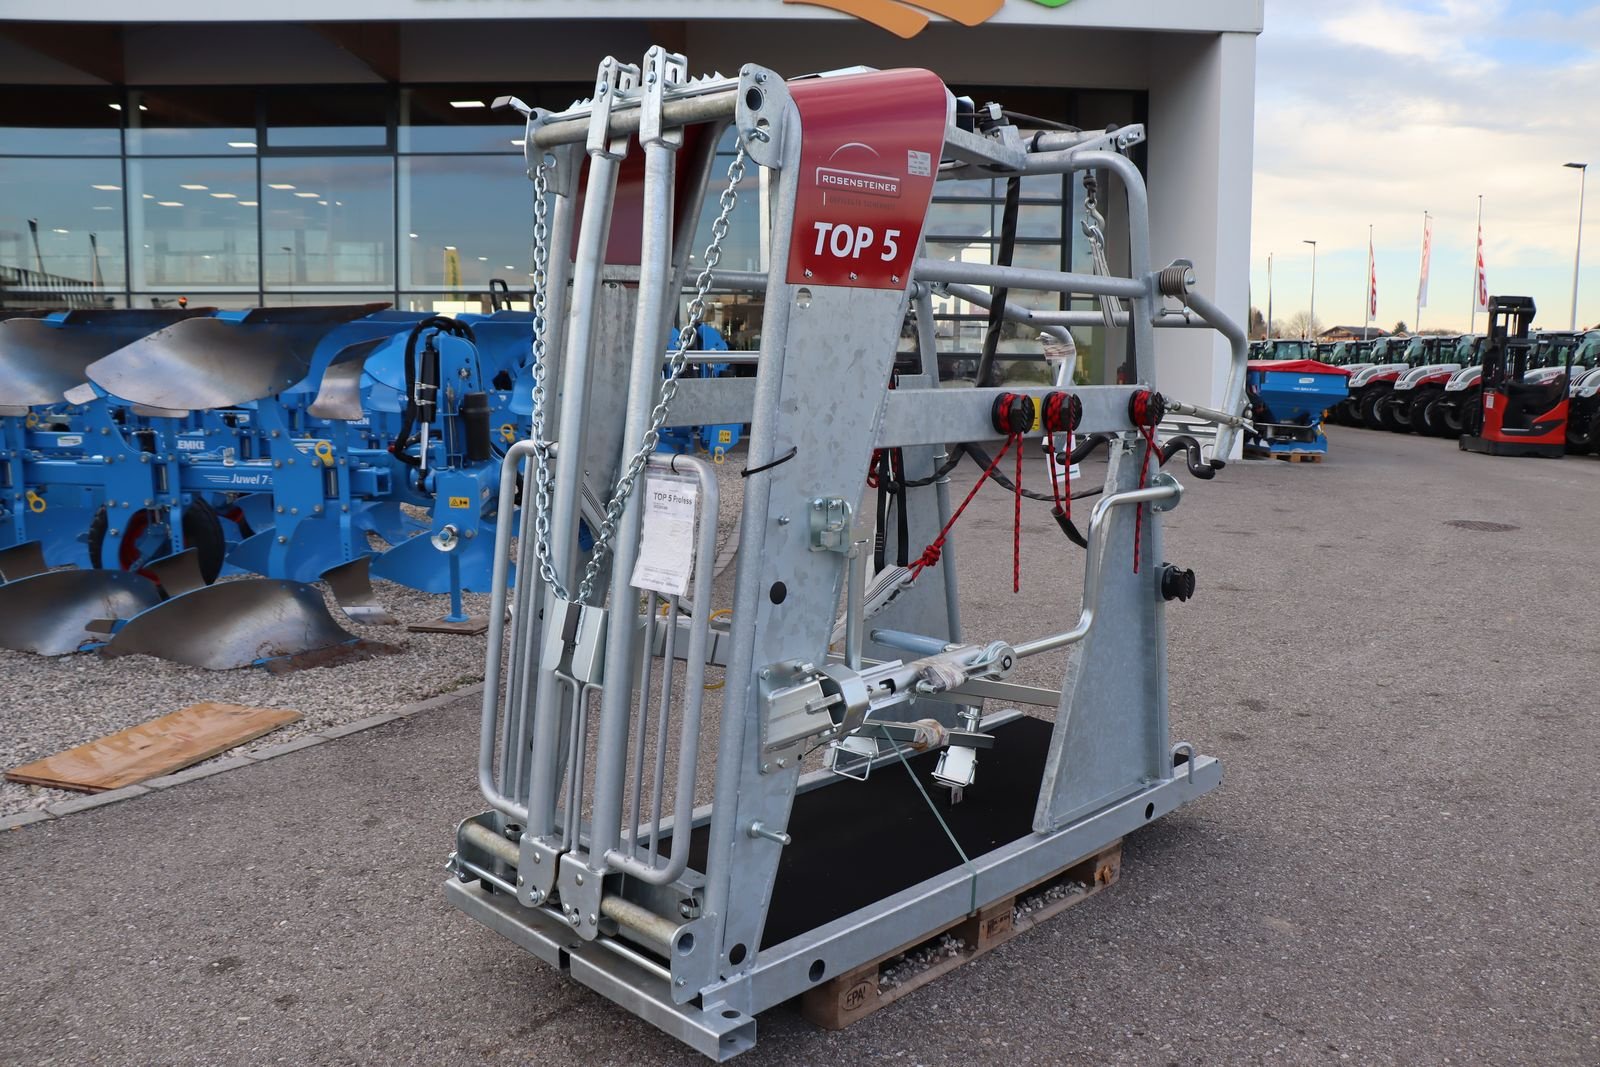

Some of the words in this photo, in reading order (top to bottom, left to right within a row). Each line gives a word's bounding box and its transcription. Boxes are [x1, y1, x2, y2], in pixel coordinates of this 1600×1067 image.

[822, 174, 897, 192] ROSENSTEINER
[814, 221, 874, 258] TOP
[880, 228, 901, 262] 5
[176, 439, 205, 450] EMKE
[231, 473, 260, 484] Juwel
[261, 474, 269, 485] 7
[653, 492, 667, 501] TOP
